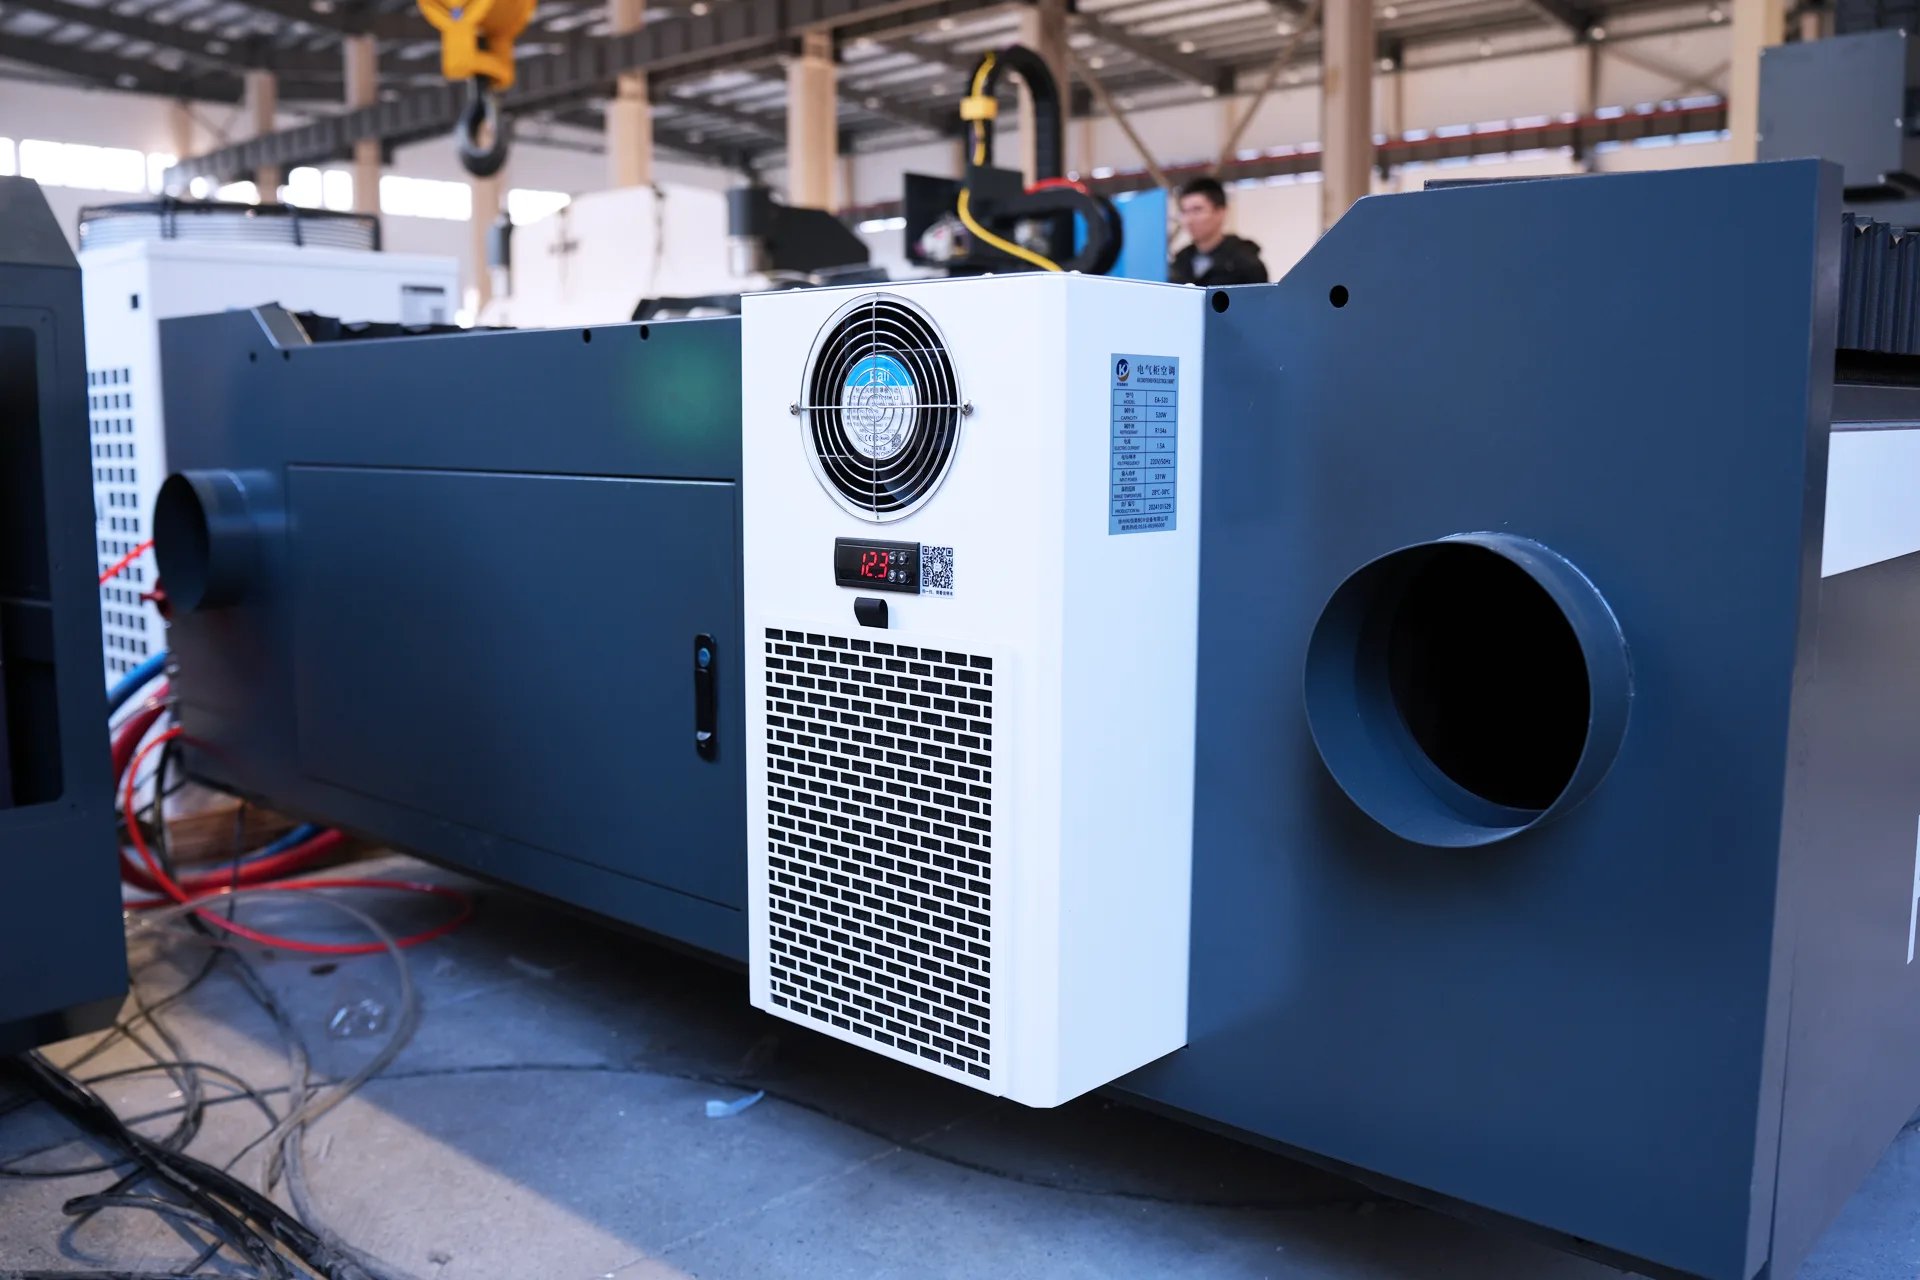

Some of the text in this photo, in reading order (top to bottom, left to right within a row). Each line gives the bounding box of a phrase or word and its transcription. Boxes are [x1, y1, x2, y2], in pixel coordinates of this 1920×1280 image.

[1137, 364, 1175, 376] 电气柜空调
